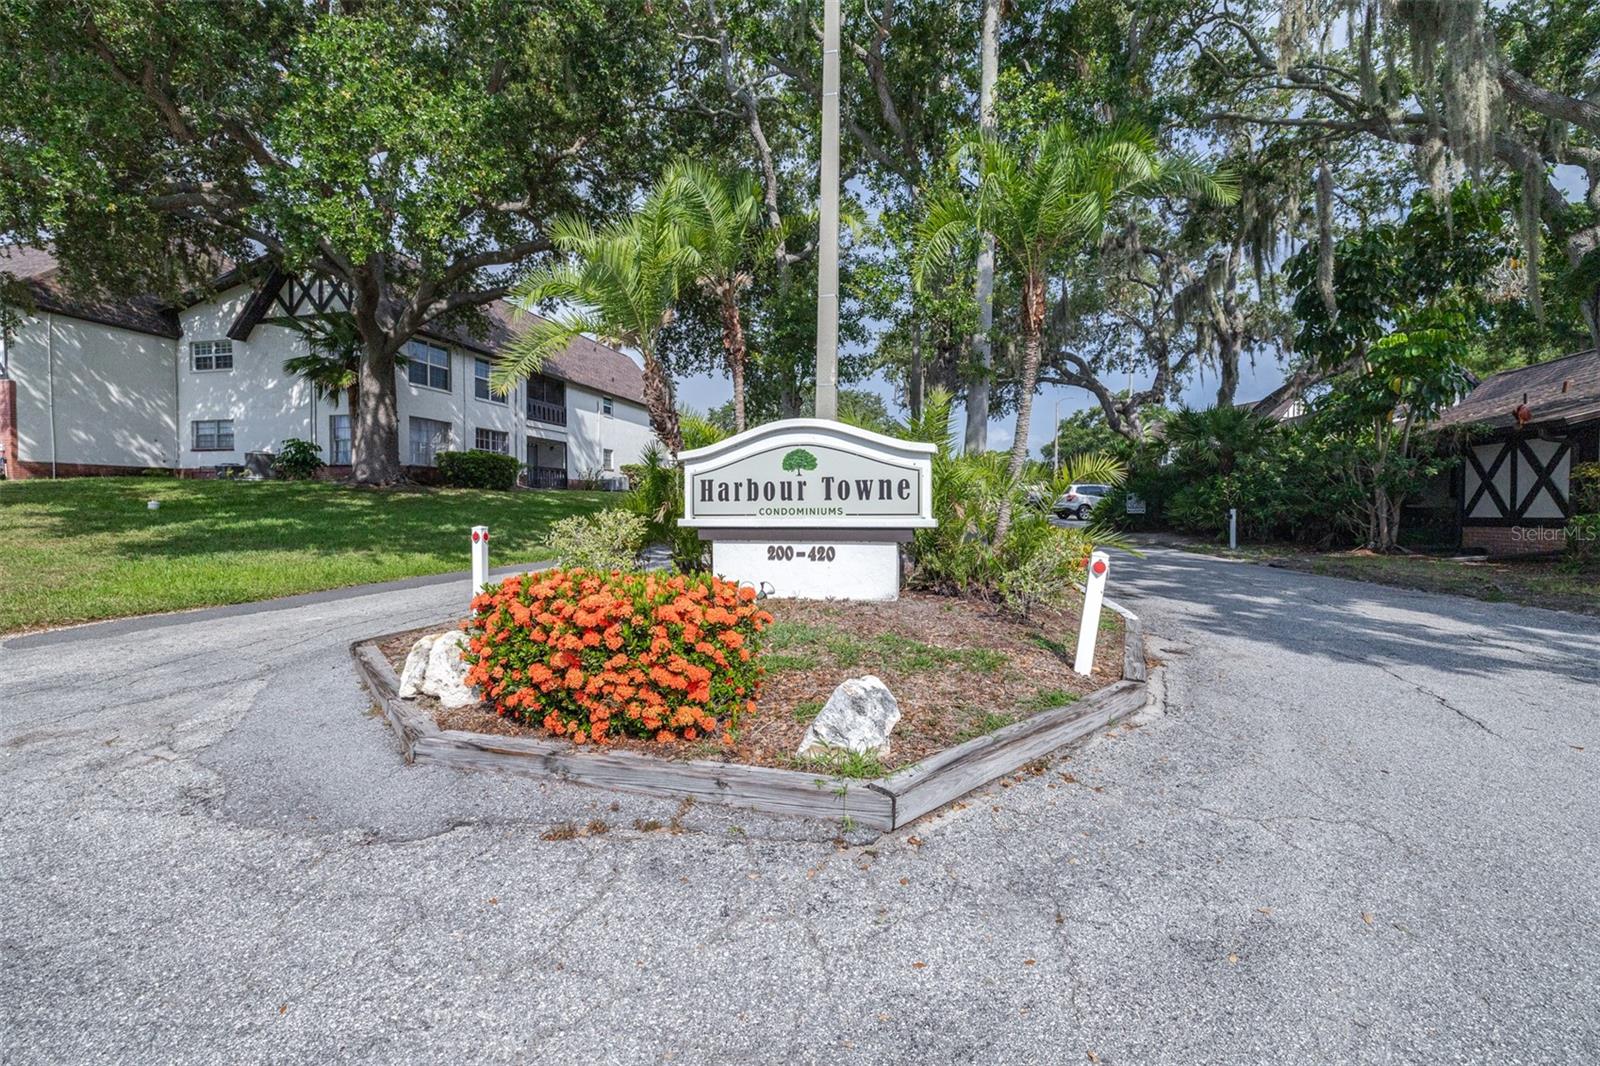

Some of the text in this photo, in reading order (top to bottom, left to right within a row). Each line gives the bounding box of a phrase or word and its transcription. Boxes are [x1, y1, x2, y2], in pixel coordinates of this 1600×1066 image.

[700, 476, 911, 502] Harbour Towne
[758, 507, 844, 516] CONDOMINIUMS
